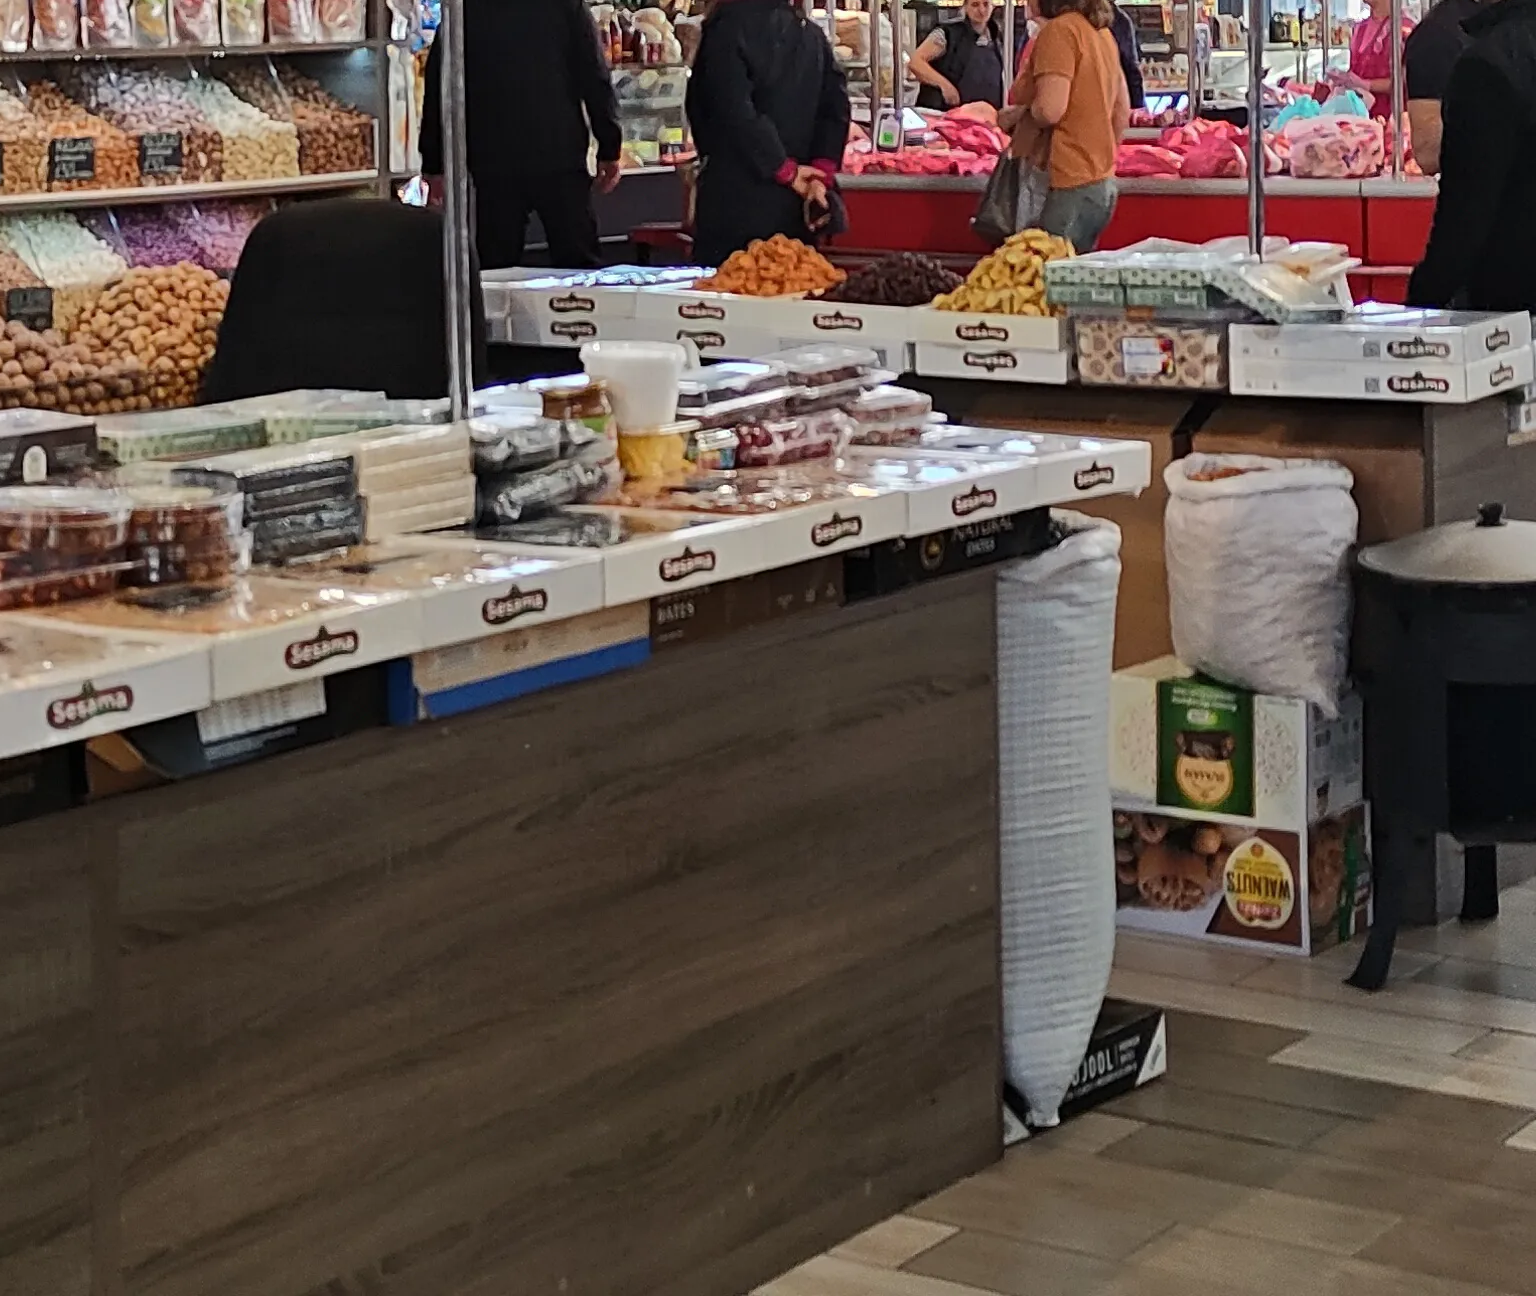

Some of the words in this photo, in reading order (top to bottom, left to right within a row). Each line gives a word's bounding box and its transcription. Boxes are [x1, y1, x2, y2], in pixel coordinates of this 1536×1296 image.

[815, 520, 861, 543] Sesama
[663, 553, 714, 578] Sesama
[487, 593, 545, 621] Sesama
[291, 635, 355, 665] Sesama
[52, 689, 128, 722] Sesama
[1226, 870, 1291, 901] WALNUTS
